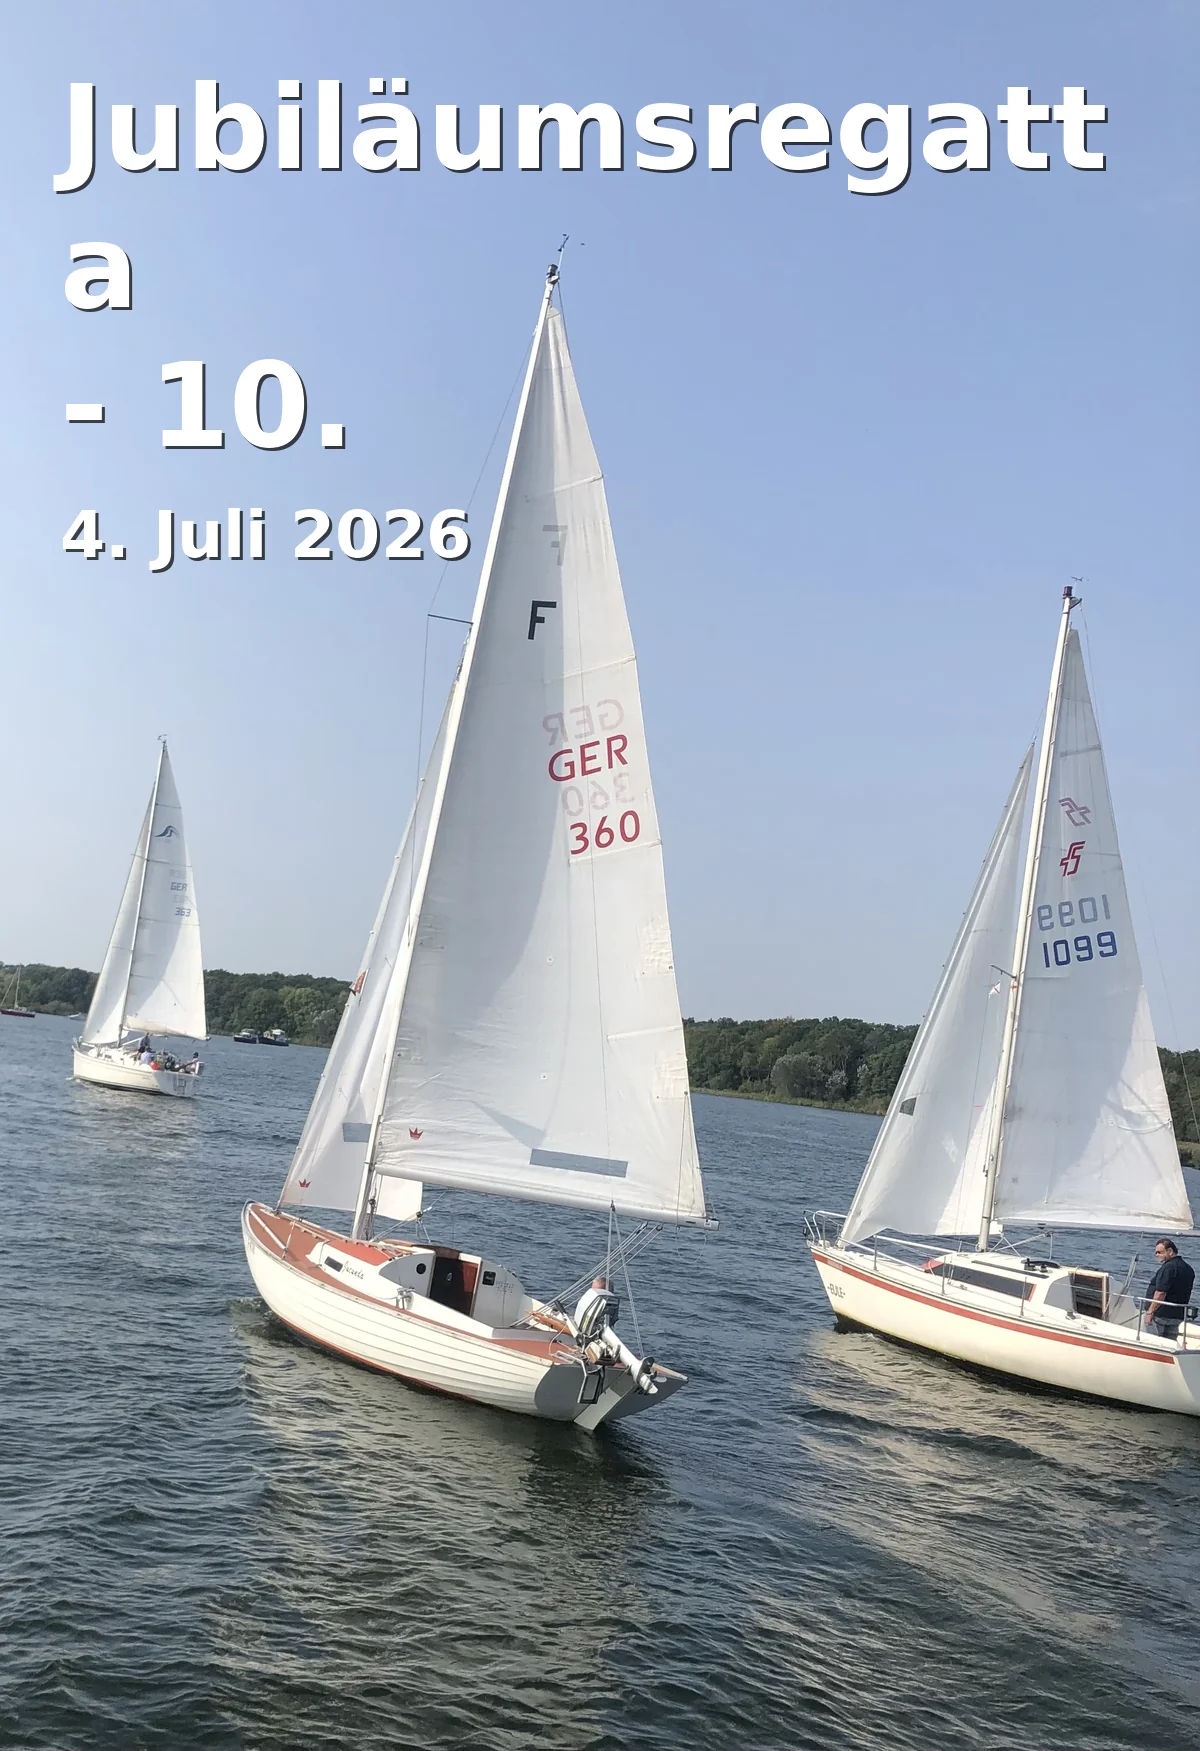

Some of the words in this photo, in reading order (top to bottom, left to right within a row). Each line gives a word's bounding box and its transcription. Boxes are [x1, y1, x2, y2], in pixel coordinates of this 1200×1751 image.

[528, 600, 557, 640] F
[548, 734, 629, 782] GER
[569, 809, 641, 855] 360
[170, 882, 188, 892] GER
[1042, 931, 1118, 968] 1099
